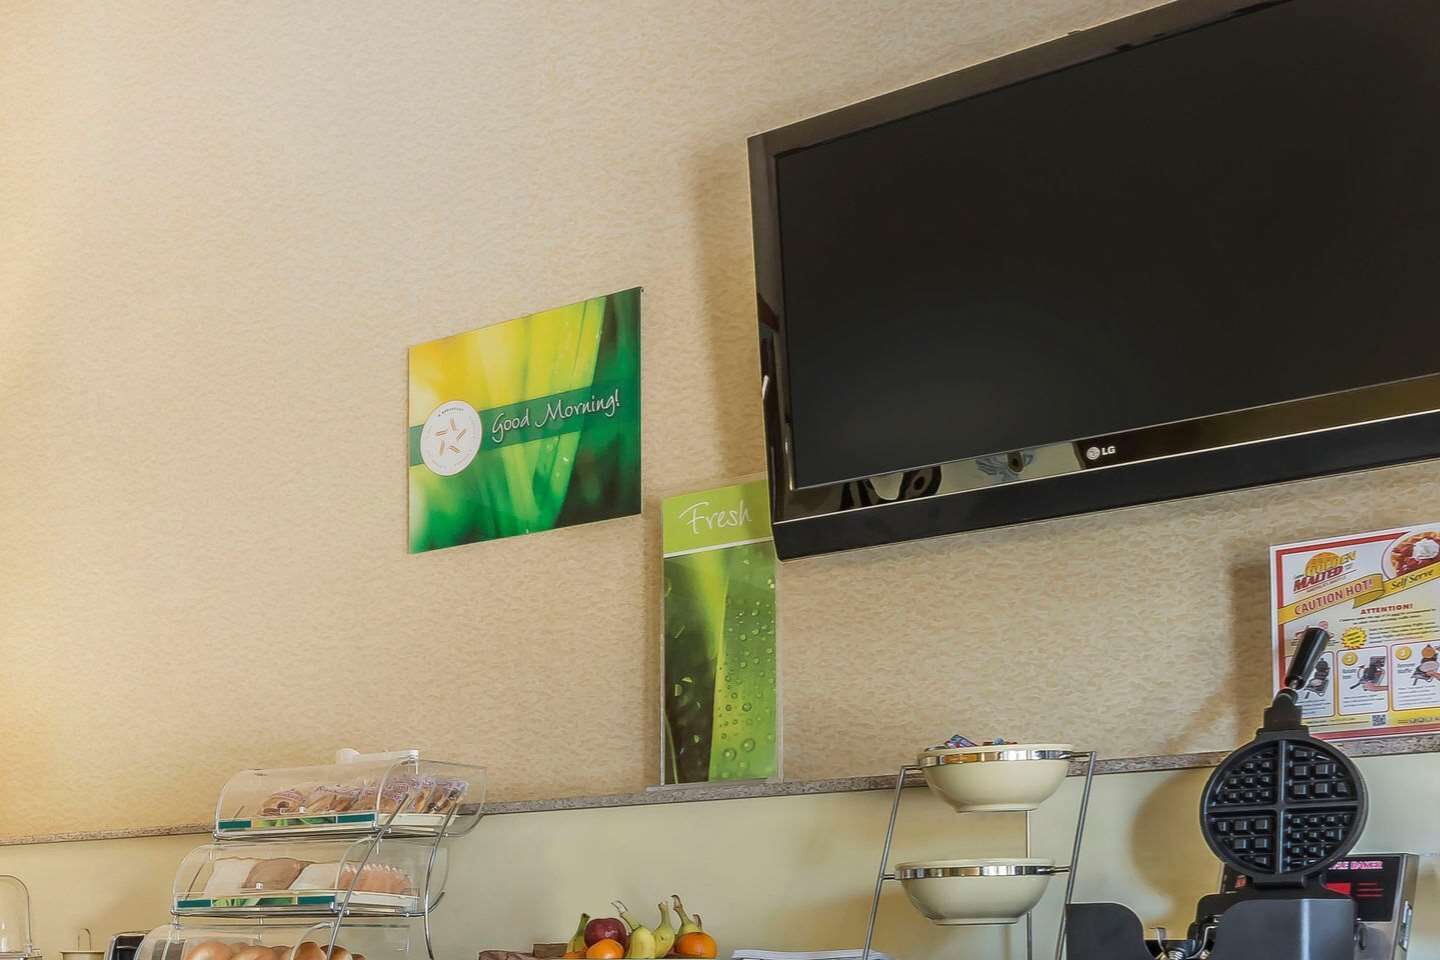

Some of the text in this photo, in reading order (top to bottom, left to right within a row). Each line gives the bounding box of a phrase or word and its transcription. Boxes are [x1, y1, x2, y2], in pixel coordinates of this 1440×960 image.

[491, 389, 620, 443] Good Morning!
[1101, 445, 1116, 456] LG
[678, 500, 753, 535] Fresh
[1293, 566, 1344, 592] MALTED
[1294, 590, 1344, 615] CAUTION
[1345, 579, 1373, 597] HOT!
[1360, 603, 1413, 614] ATTENTION!
